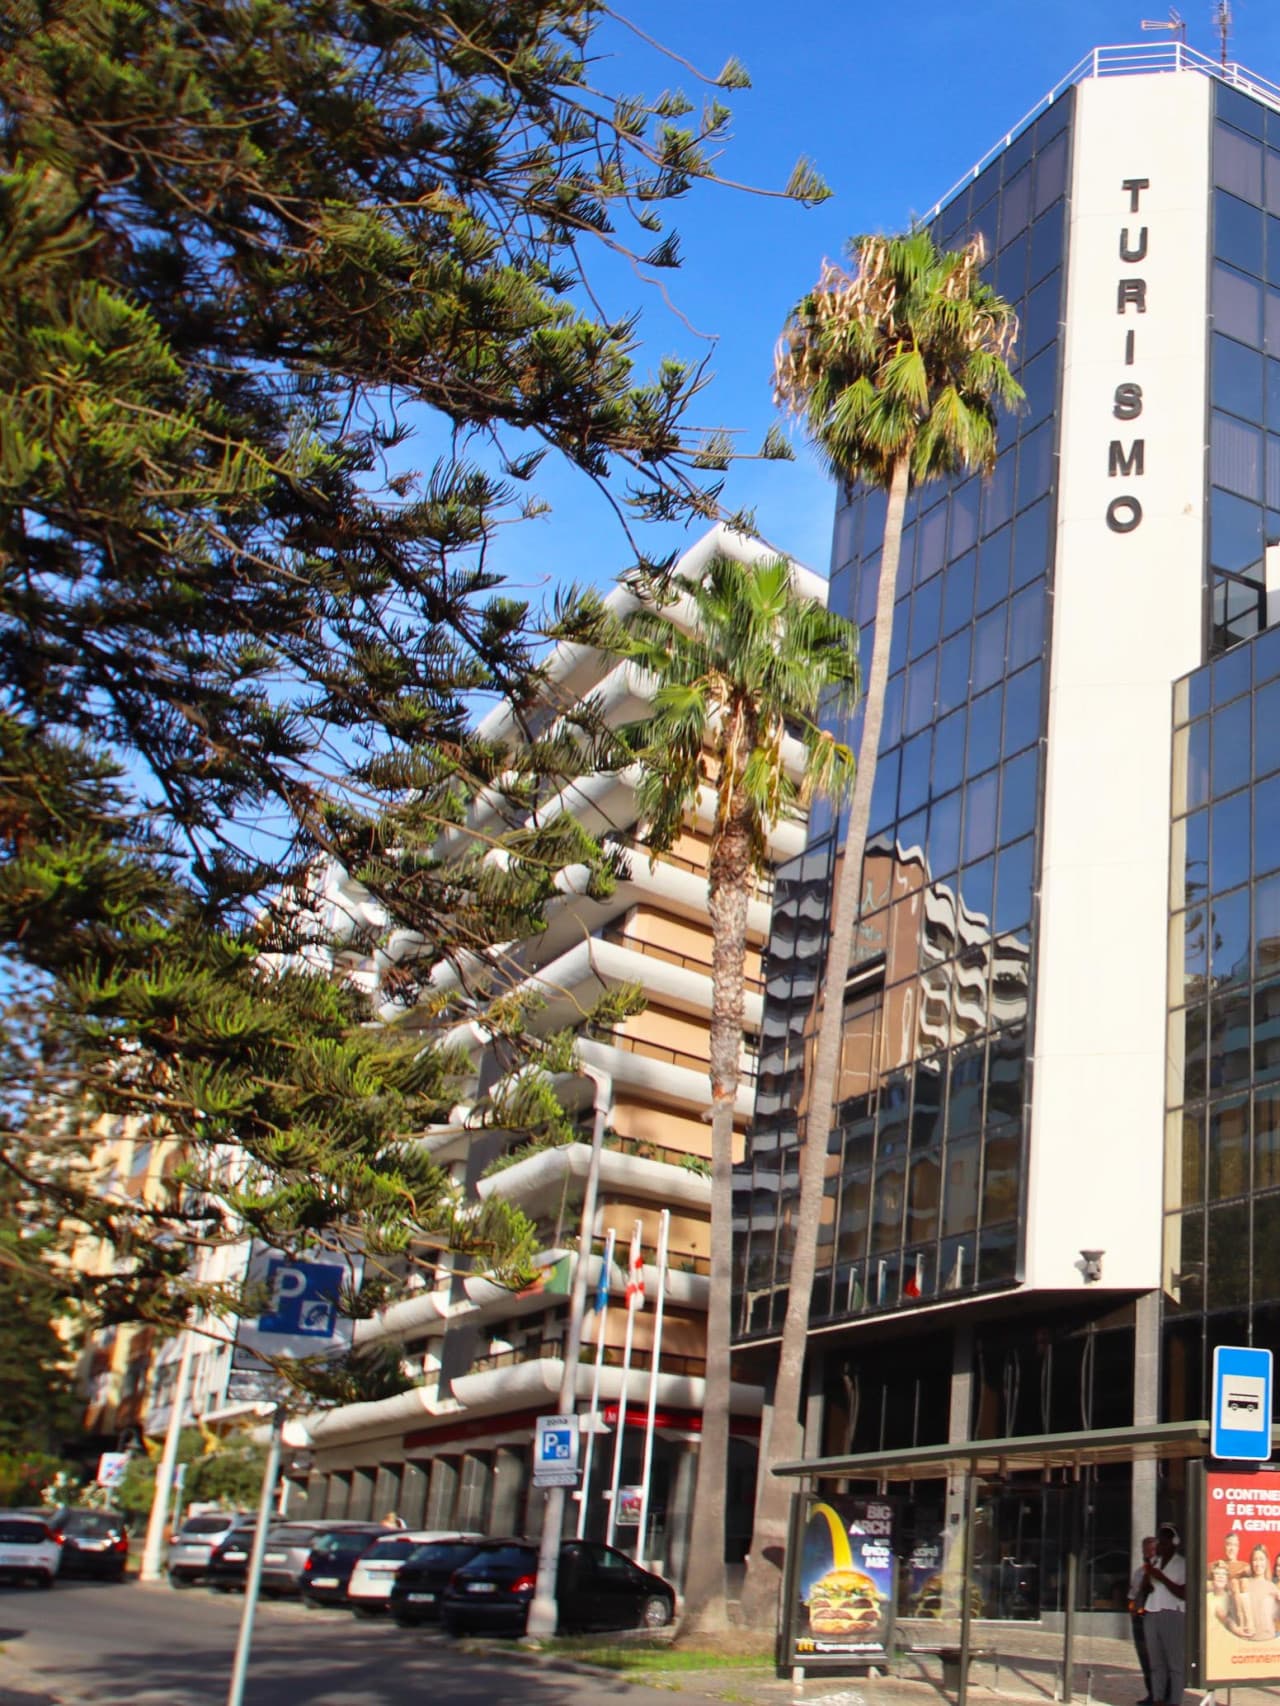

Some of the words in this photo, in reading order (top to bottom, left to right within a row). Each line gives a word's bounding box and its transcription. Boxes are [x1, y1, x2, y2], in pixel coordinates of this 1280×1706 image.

[1105, 178, 1150, 534] TURISMO
[270, 1267, 307, 1316] P
[545, 1433, 558, 1453] P
[1212, 1487, 1224, 1500] O
[866, 1505, 891, 1520] BIG
[1226, 1501, 1236, 1515] É
[1237, 1504, 1255, 1516] DE
[849, 1520, 891, 1535] ARCH
[1231, 1519, 1242, 1531] A
